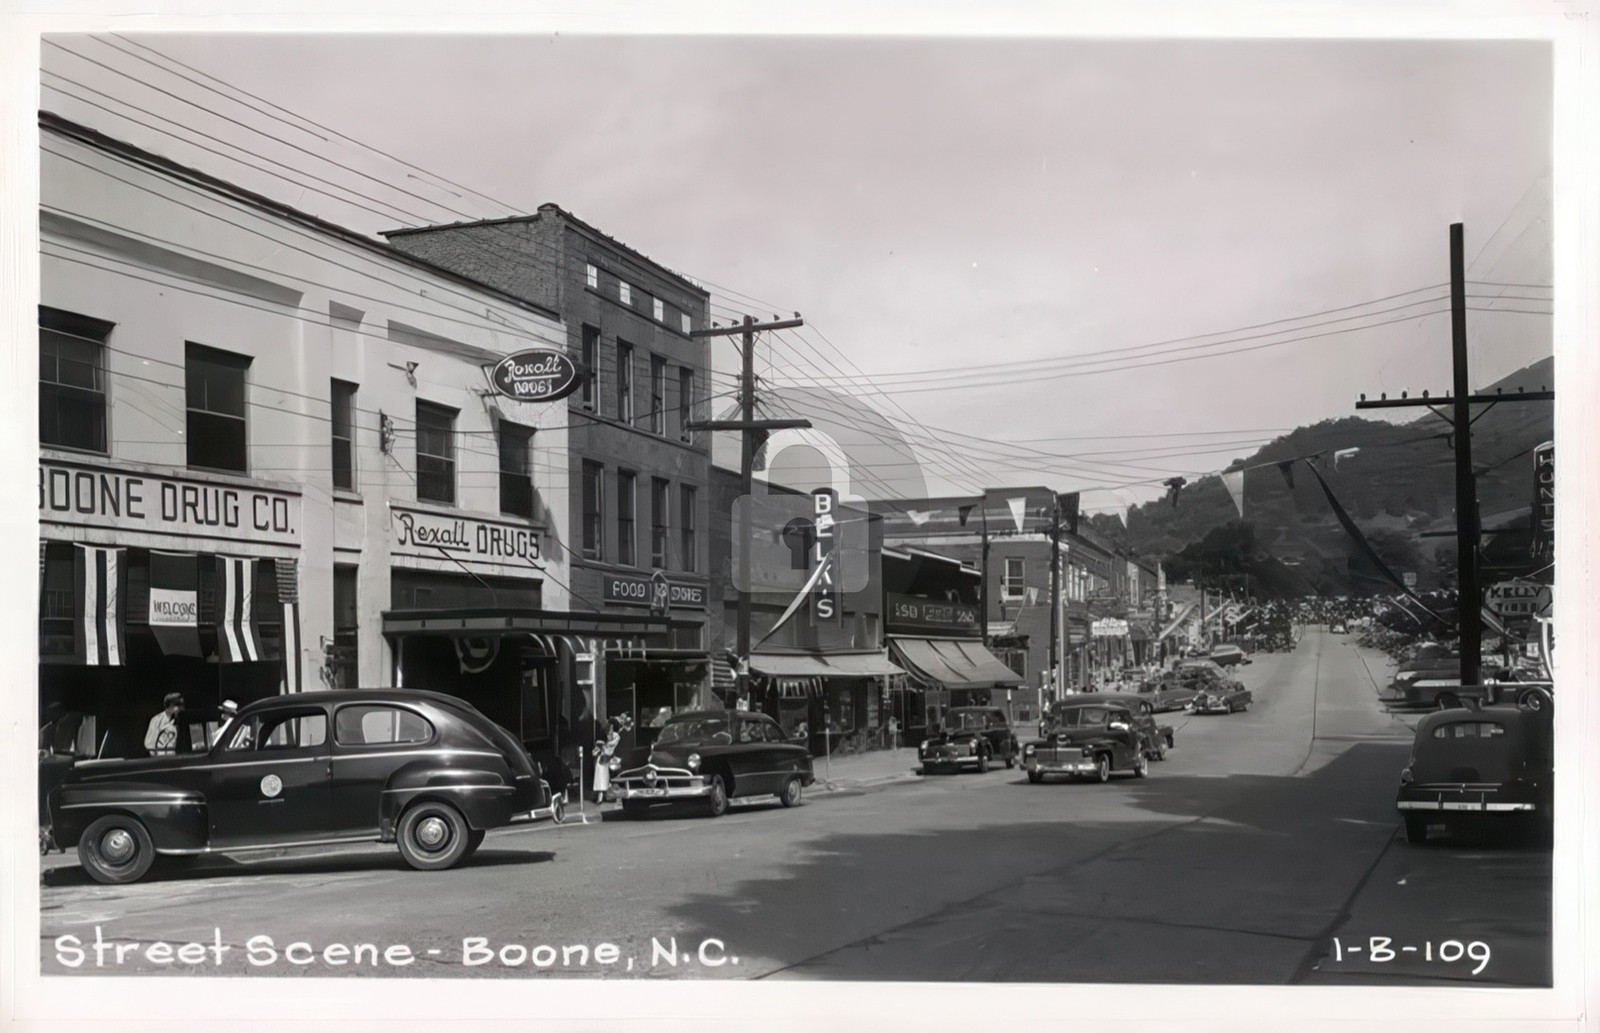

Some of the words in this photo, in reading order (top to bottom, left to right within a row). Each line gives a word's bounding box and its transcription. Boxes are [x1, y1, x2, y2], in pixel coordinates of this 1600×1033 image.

[161, 482, 239, 528] DRUG
[252, 494, 295, 534] CO.
[398, 513, 470, 552] Rexall
[477, 524, 540, 559] DRUGS
[612, 580, 646, 598] FOOD
